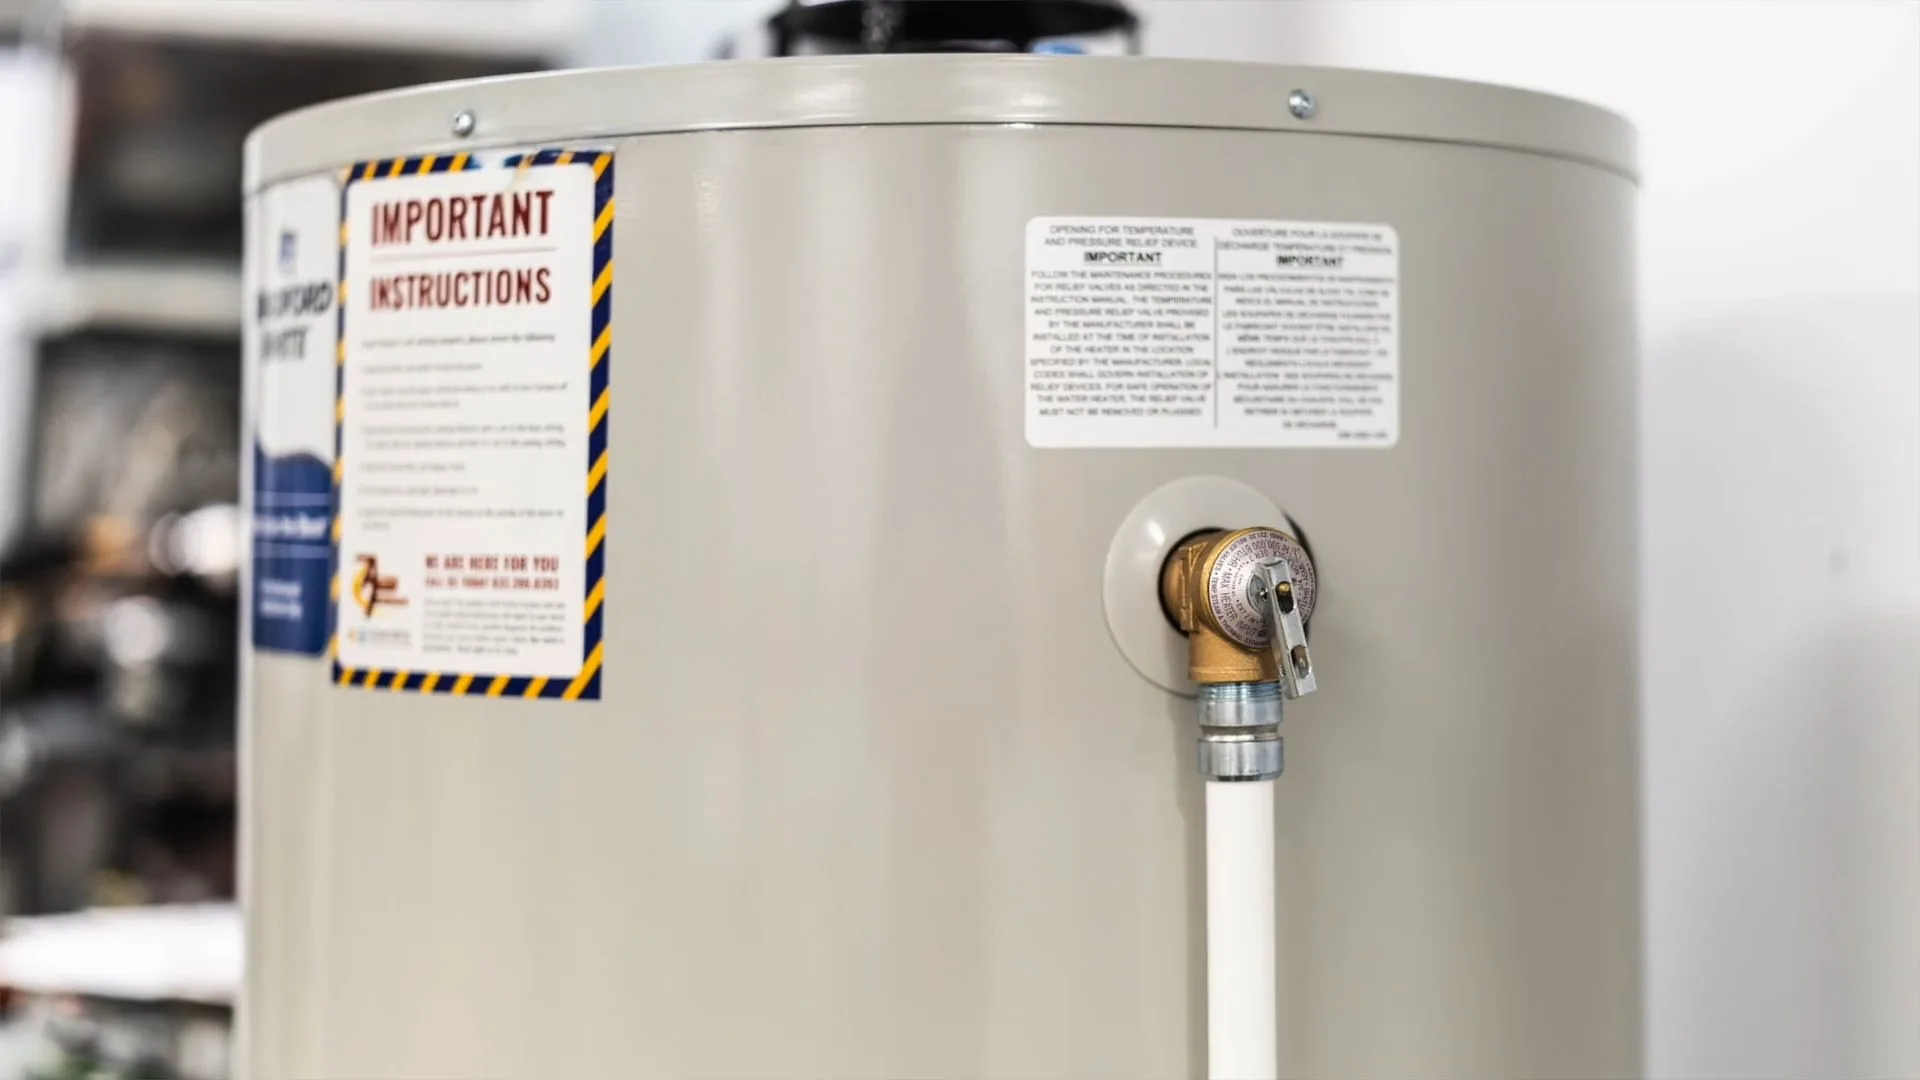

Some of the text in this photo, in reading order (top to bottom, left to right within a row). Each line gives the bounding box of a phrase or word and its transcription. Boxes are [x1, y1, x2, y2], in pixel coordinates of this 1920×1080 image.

[371, 190, 555, 247] IMPORTANT
[1050, 225, 1194, 235] OPENING FOR TEMPERATURE
[1045, 238, 1197, 247] AND PRESSURE RELIEF DEVICE
[1084, 252, 1162, 263] IMPORTANT
[1276, 256, 1344, 267] IMPORTANT
[1090, 271, 1150, 279] MAINTENANCE
[369, 268, 552, 312] INSTRUCTIONS
[1035, 283, 1051, 291] FOR
[1031, 296, 1088, 304] INSTRUCTION
[1083, 321, 1153, 329] MANUFACTURER
[1033, 333, 1079, 341] INSTALLED
[1083, 333, 1093, 341] AT
[1133, 346, 1148, 354] THE
[1094, 358, 1109, 366] THE
[1106, 383, 1123, 391] FOR
[504, 555, 528, 571] FOR
[534, 555, 559, 572] YOU
[1220, 571, 1231, 588] MAX
[1221, 592, 1237, 622] HEATER
